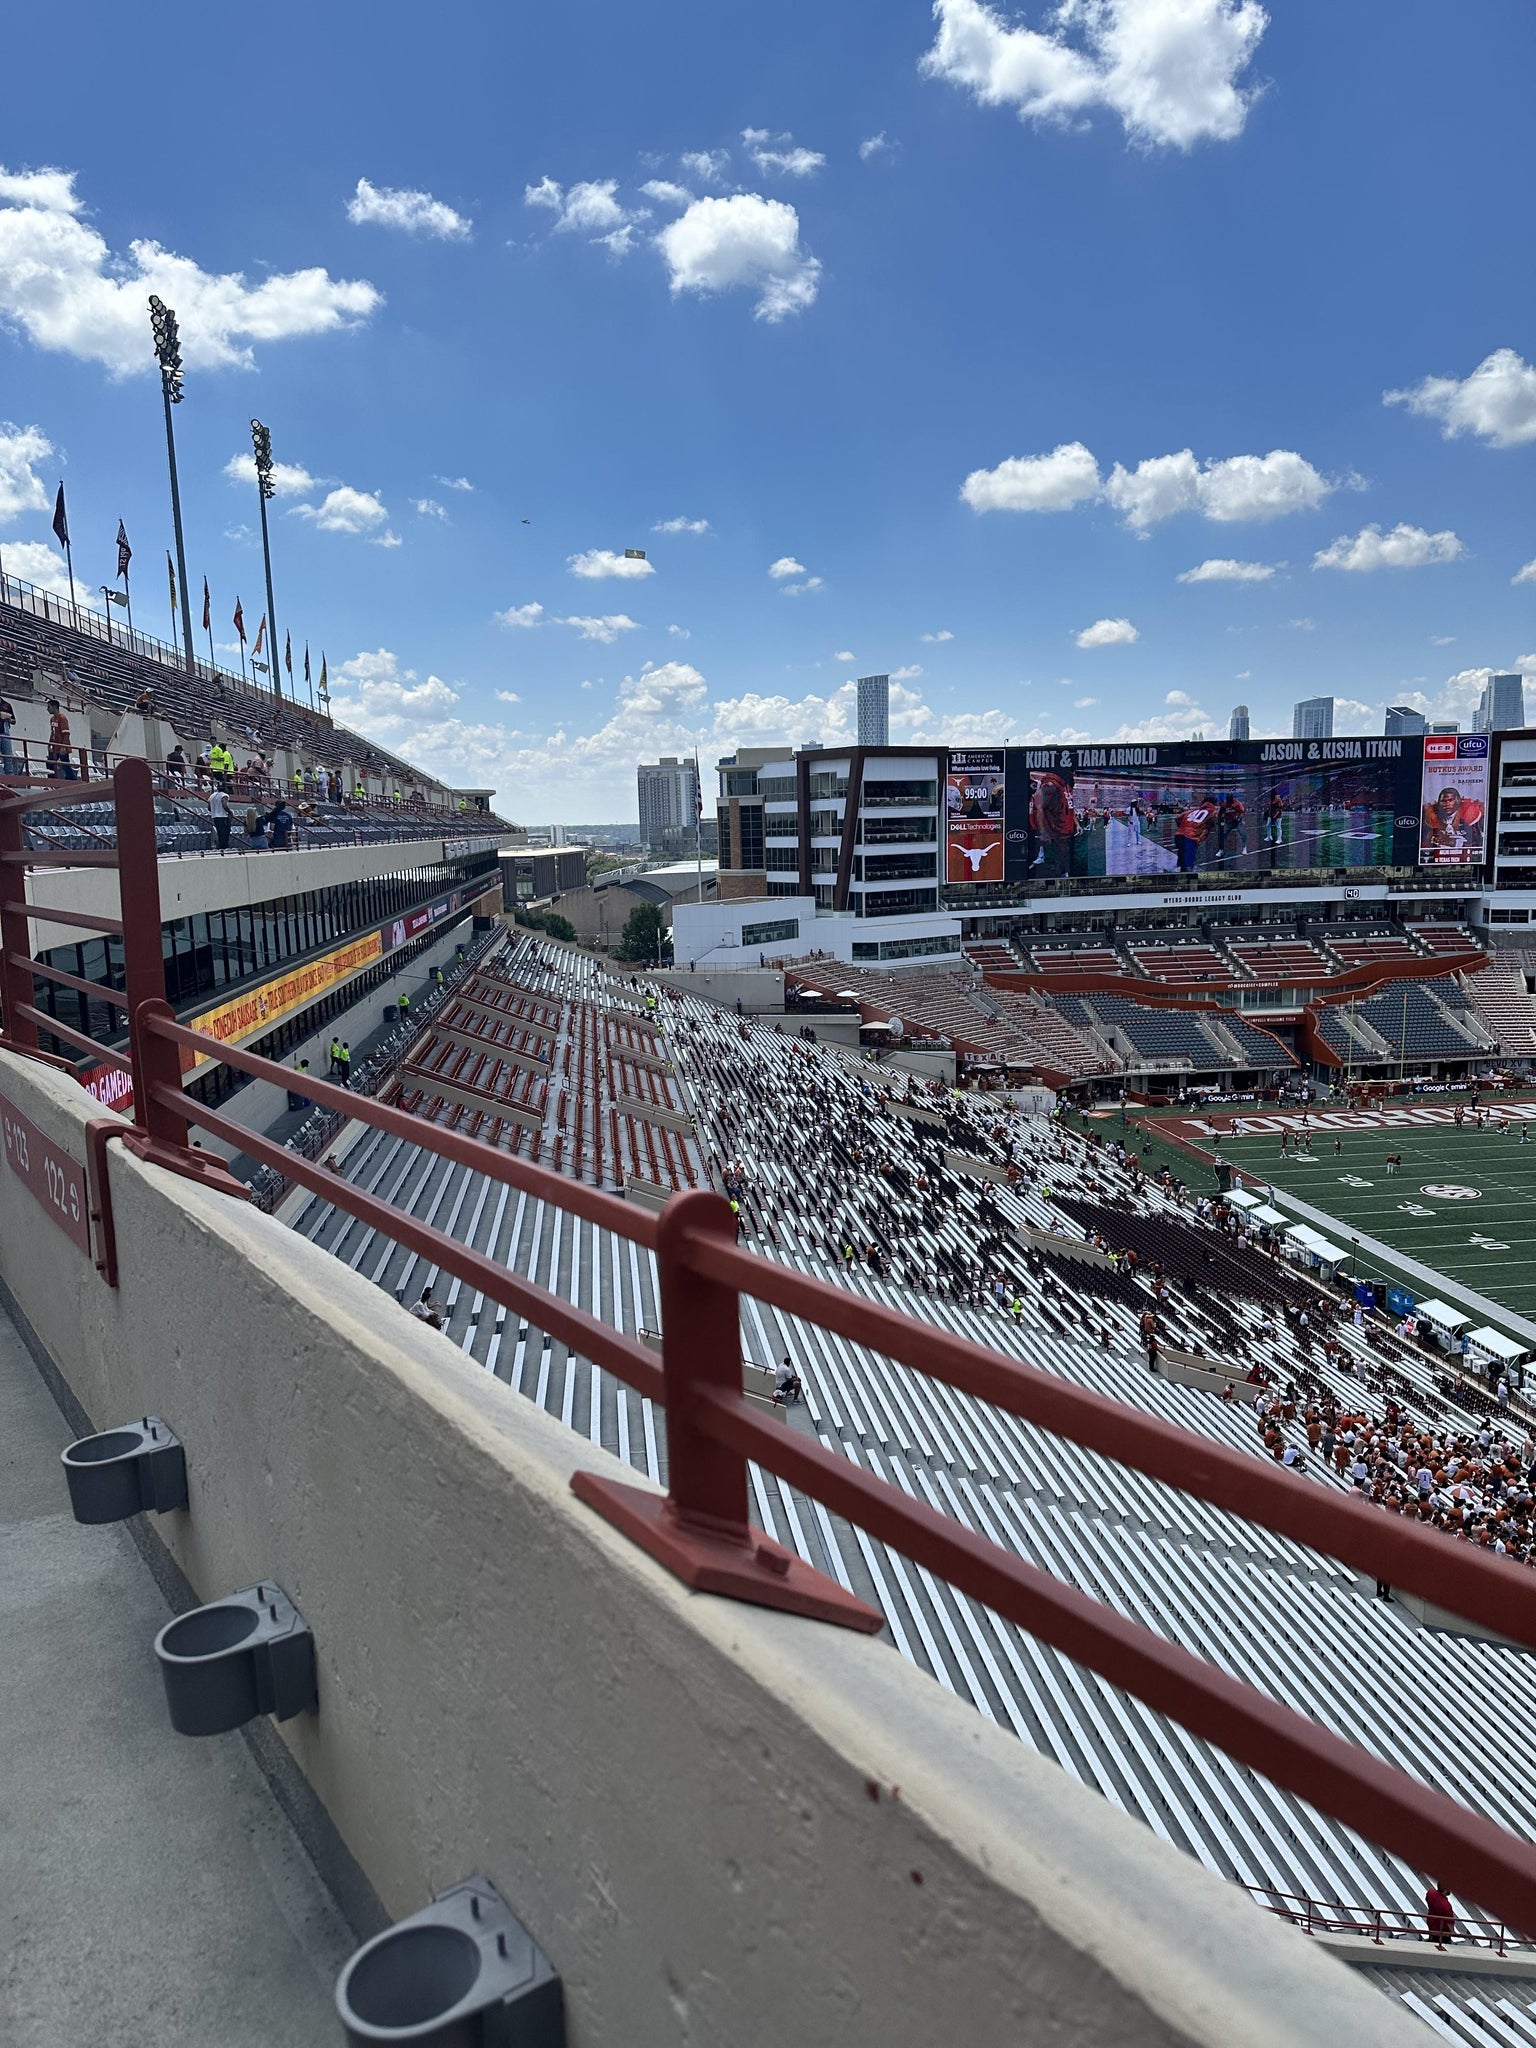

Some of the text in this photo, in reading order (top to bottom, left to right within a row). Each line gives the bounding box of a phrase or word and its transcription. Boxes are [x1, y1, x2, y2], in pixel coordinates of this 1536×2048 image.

[1260, 740, 1402, 761] JASON & KISHA ITKIN
[1463, 740, 1482, 749] ufcu
[1025, 747, 1157, 769] KURT & TARA ARNOLD
[964, 787, 987, 799] 99:00
[967, 823, 1001, 831] Technologies
[1398, 818, 1415, 826] ufcu
[965, 1053, 1006, 1062] TEXAS
[100, 1069, 134, 1105] GAMEDA
[1422, 1084, 1445, 1092] Google
[1207, 1092, 1255, 1102] Google Gmini
[12, 1122, 68, 1215] 123 122
[1337, 1173, 1375, 1188] 20
[1396, 1200, 1437, 1216] 30
[1467, 1231, 1511, 1250] 40
